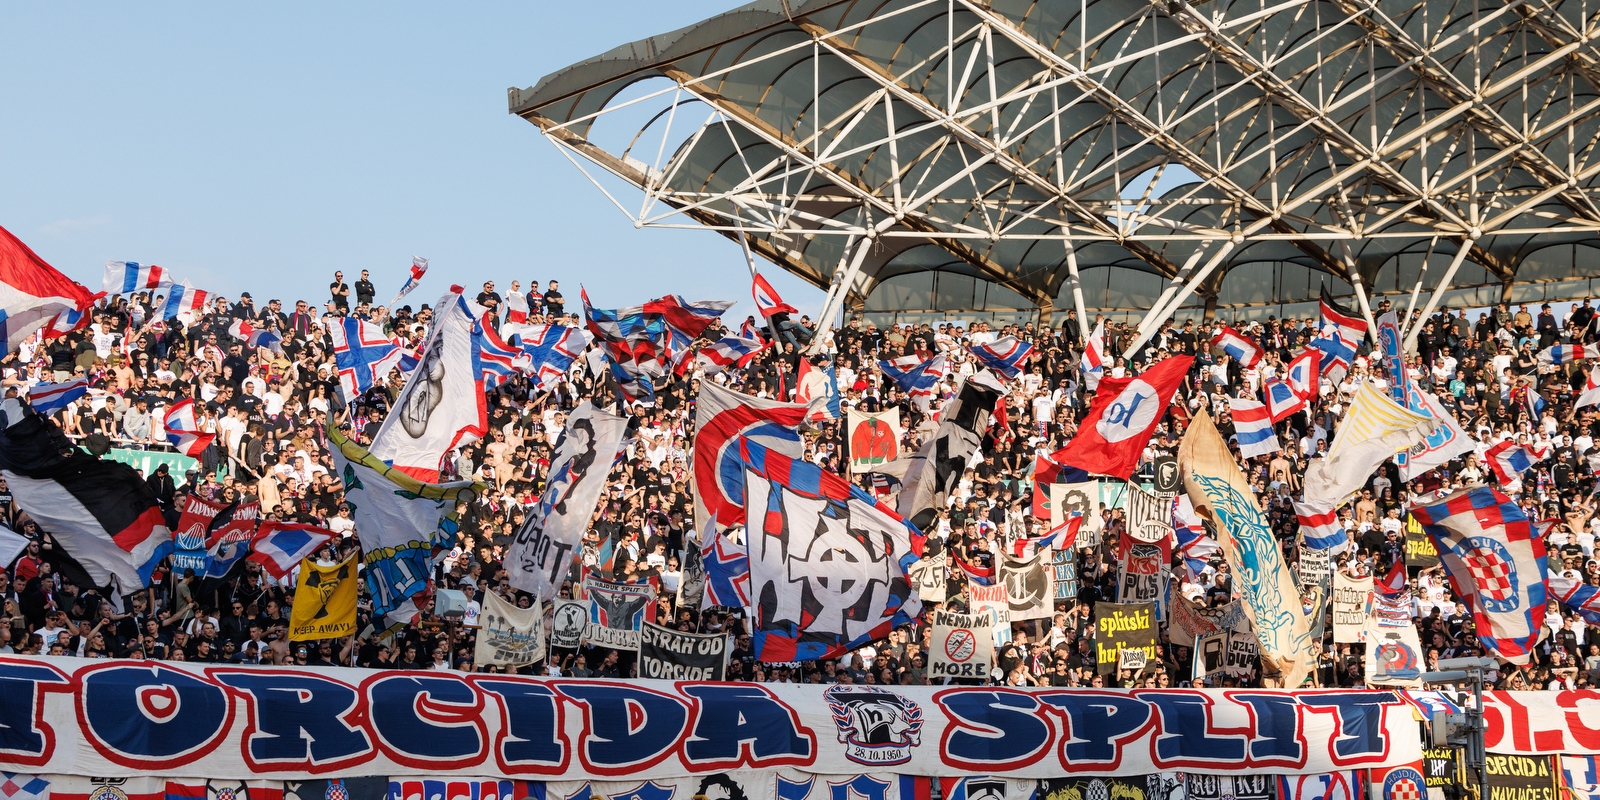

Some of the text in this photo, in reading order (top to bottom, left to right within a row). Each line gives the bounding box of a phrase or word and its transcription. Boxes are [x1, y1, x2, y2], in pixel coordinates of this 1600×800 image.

[1129, 485, 1172, 535] TOTAL
[594, 581, 619, 591] HAJDUK
[970, 584, 1009, 605] TORCIDA
[1123, 572, 1159, 599] PLUS
[293, 622, 350, 635] KEEP AWAY!
[936, 611, 990, 628] NEMA NA
[1100, 608, 1150, 638] splitski
[642, 624, 723, 655] STRAH OD
[494, 649, 534, 662] SPLIT
[643, 655, 714, 680] TORCIDE
[932, 661, 987, 676] MORE
[0, 657, 1407, 775] TORCIDA SPLIT
[1422, 748, 1453, 760] MAČAK
[1387, 768, 1421, 784] HAJDUK
[1485, 756, 1548, 777] ORCIDA
